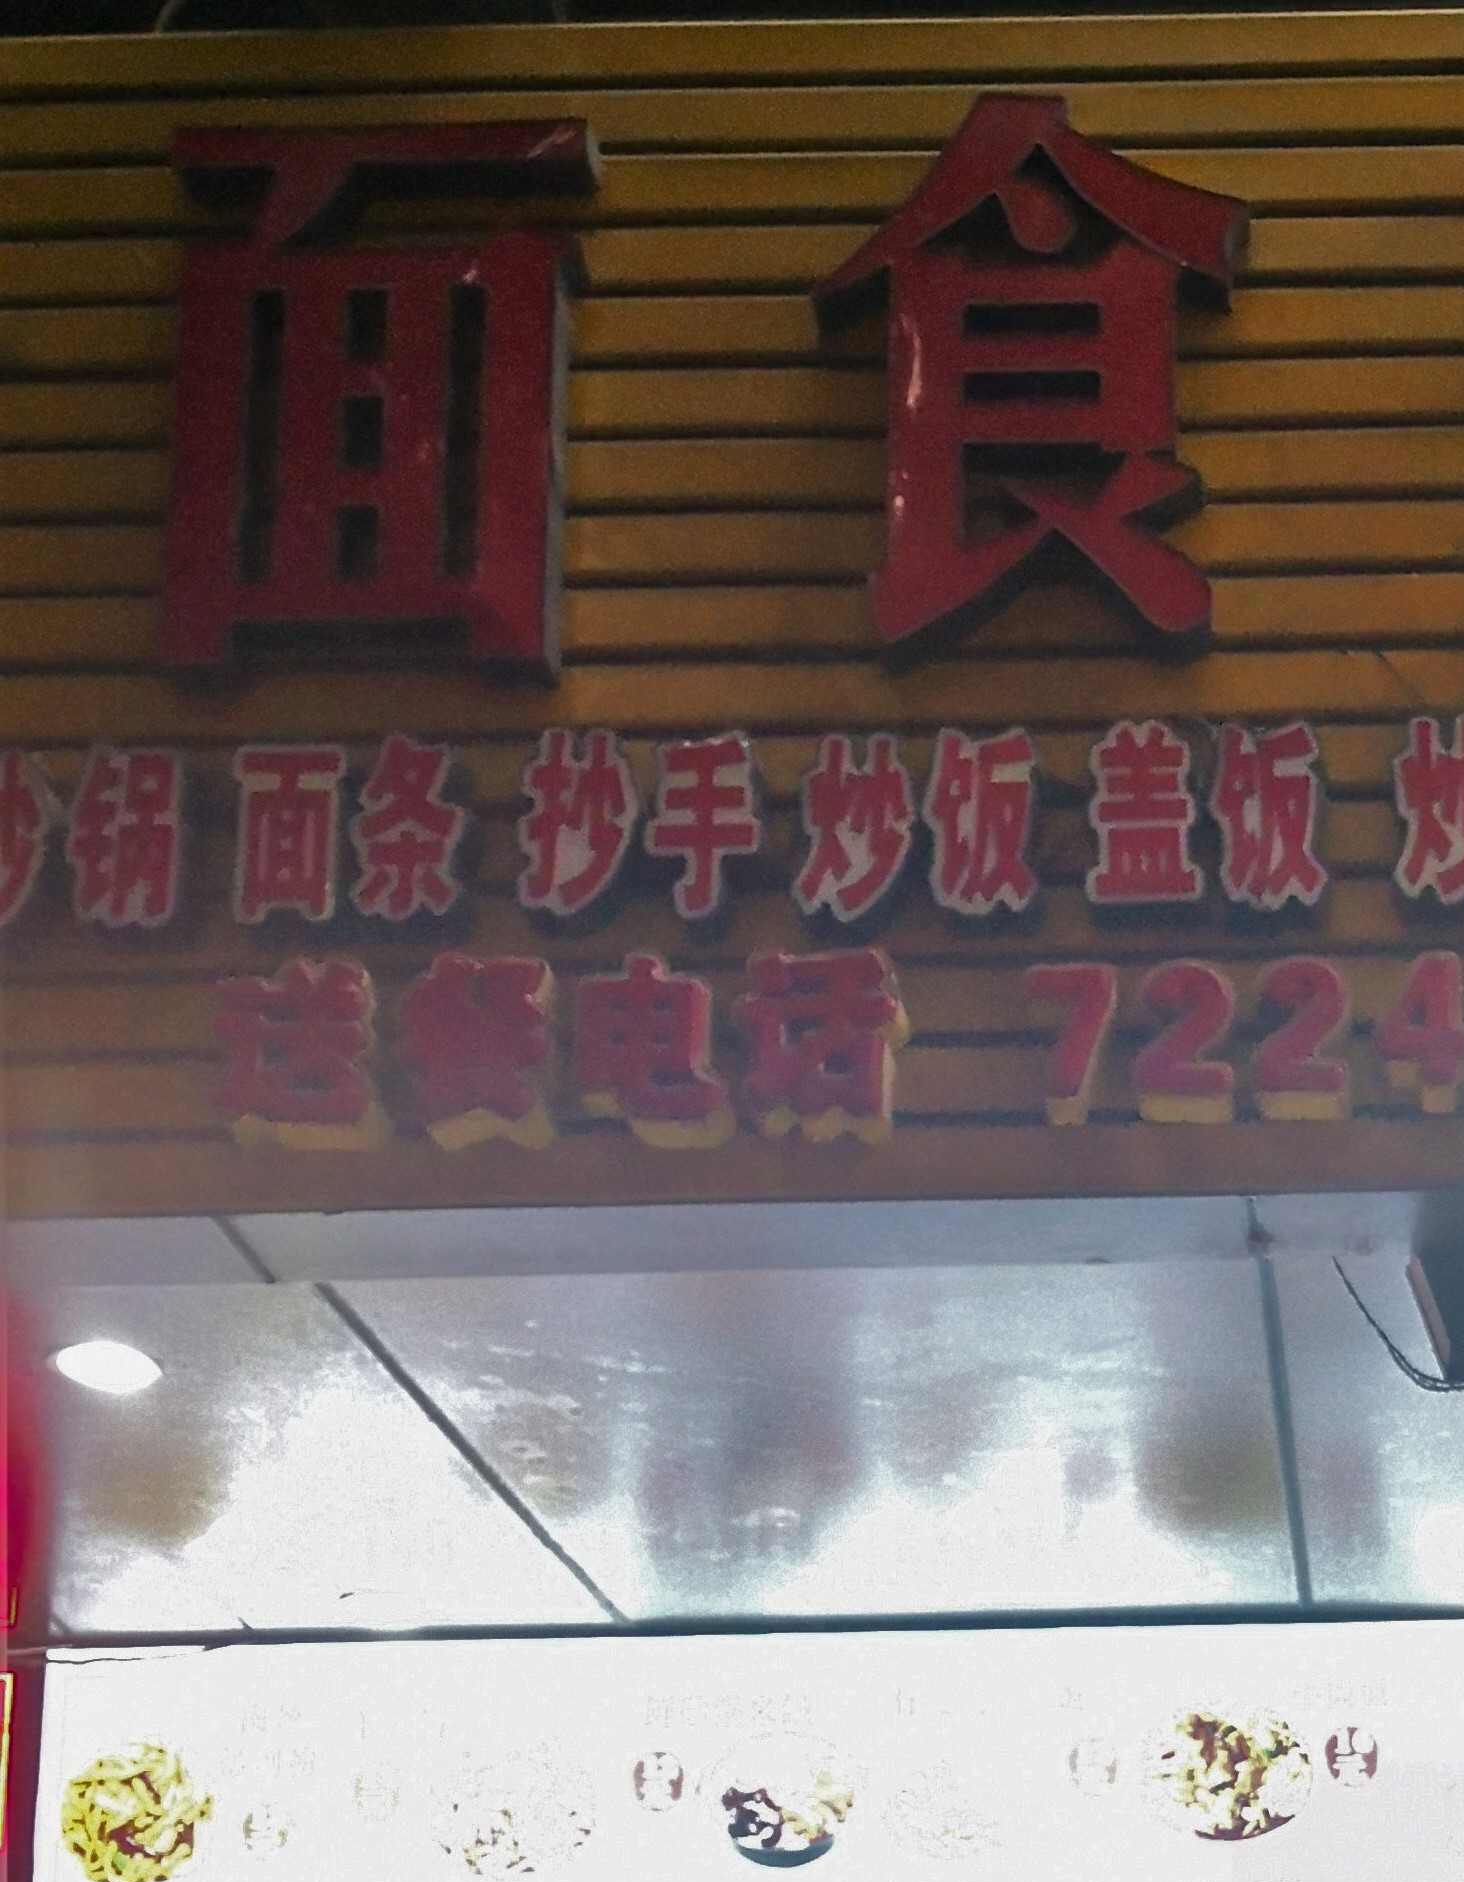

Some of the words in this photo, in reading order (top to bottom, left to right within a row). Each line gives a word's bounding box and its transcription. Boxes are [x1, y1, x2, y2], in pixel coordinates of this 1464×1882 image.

[233, 732, 467, 926] 面条
[517, 726, 762, 919] 抄手
[797, 725, 1037, 924] 炒饭
[1084, 718, 1329, 911] 盖饭
